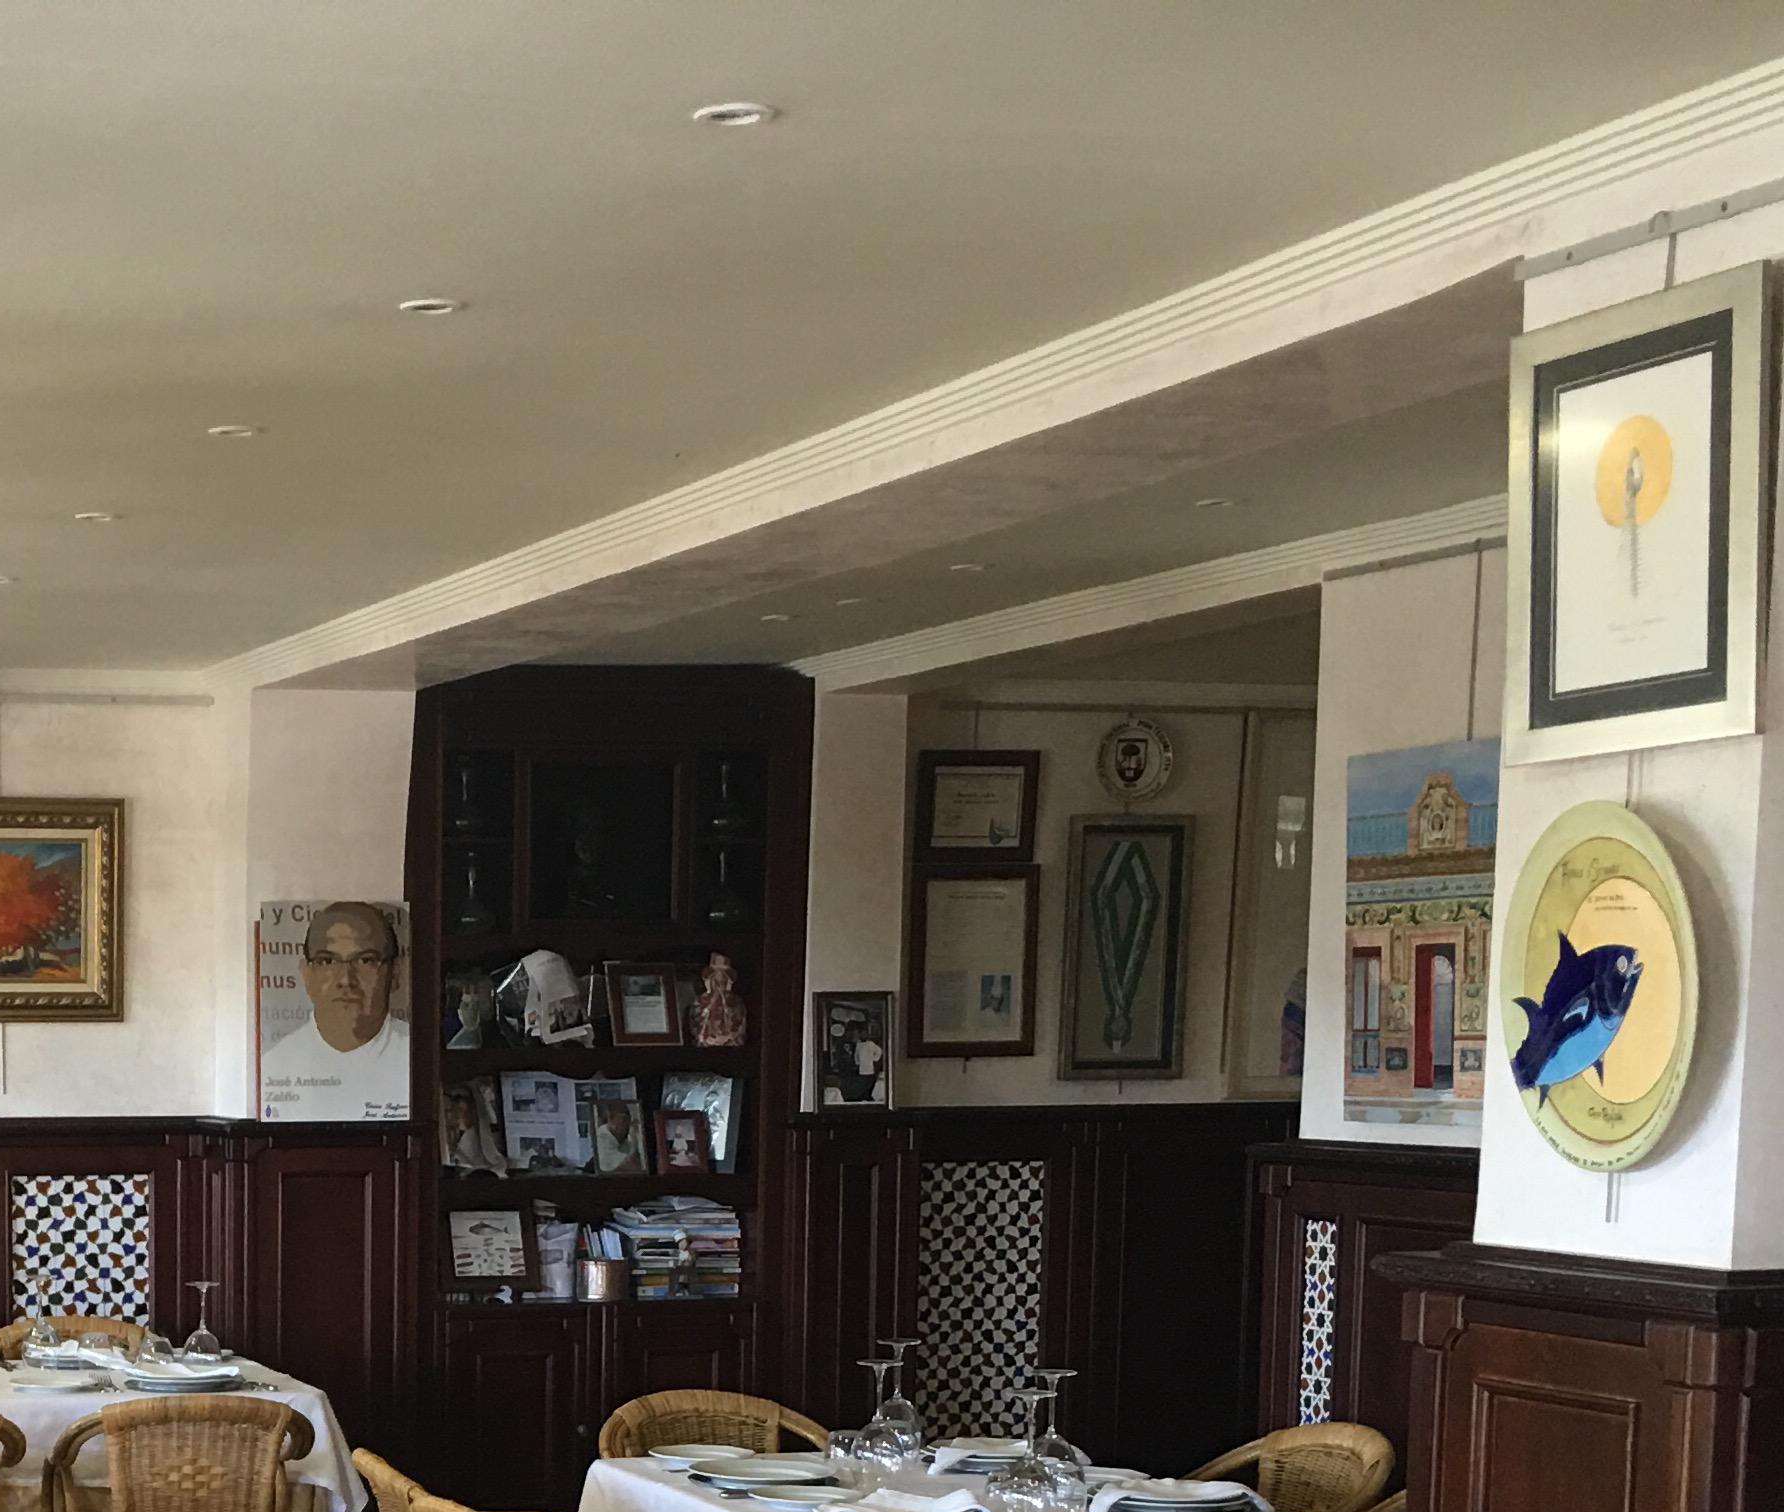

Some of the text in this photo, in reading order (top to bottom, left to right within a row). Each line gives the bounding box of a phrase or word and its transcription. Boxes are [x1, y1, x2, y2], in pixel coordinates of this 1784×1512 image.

[272, 907, 283, 926] y
[265, 1075, 342, 1087] José Antonio
